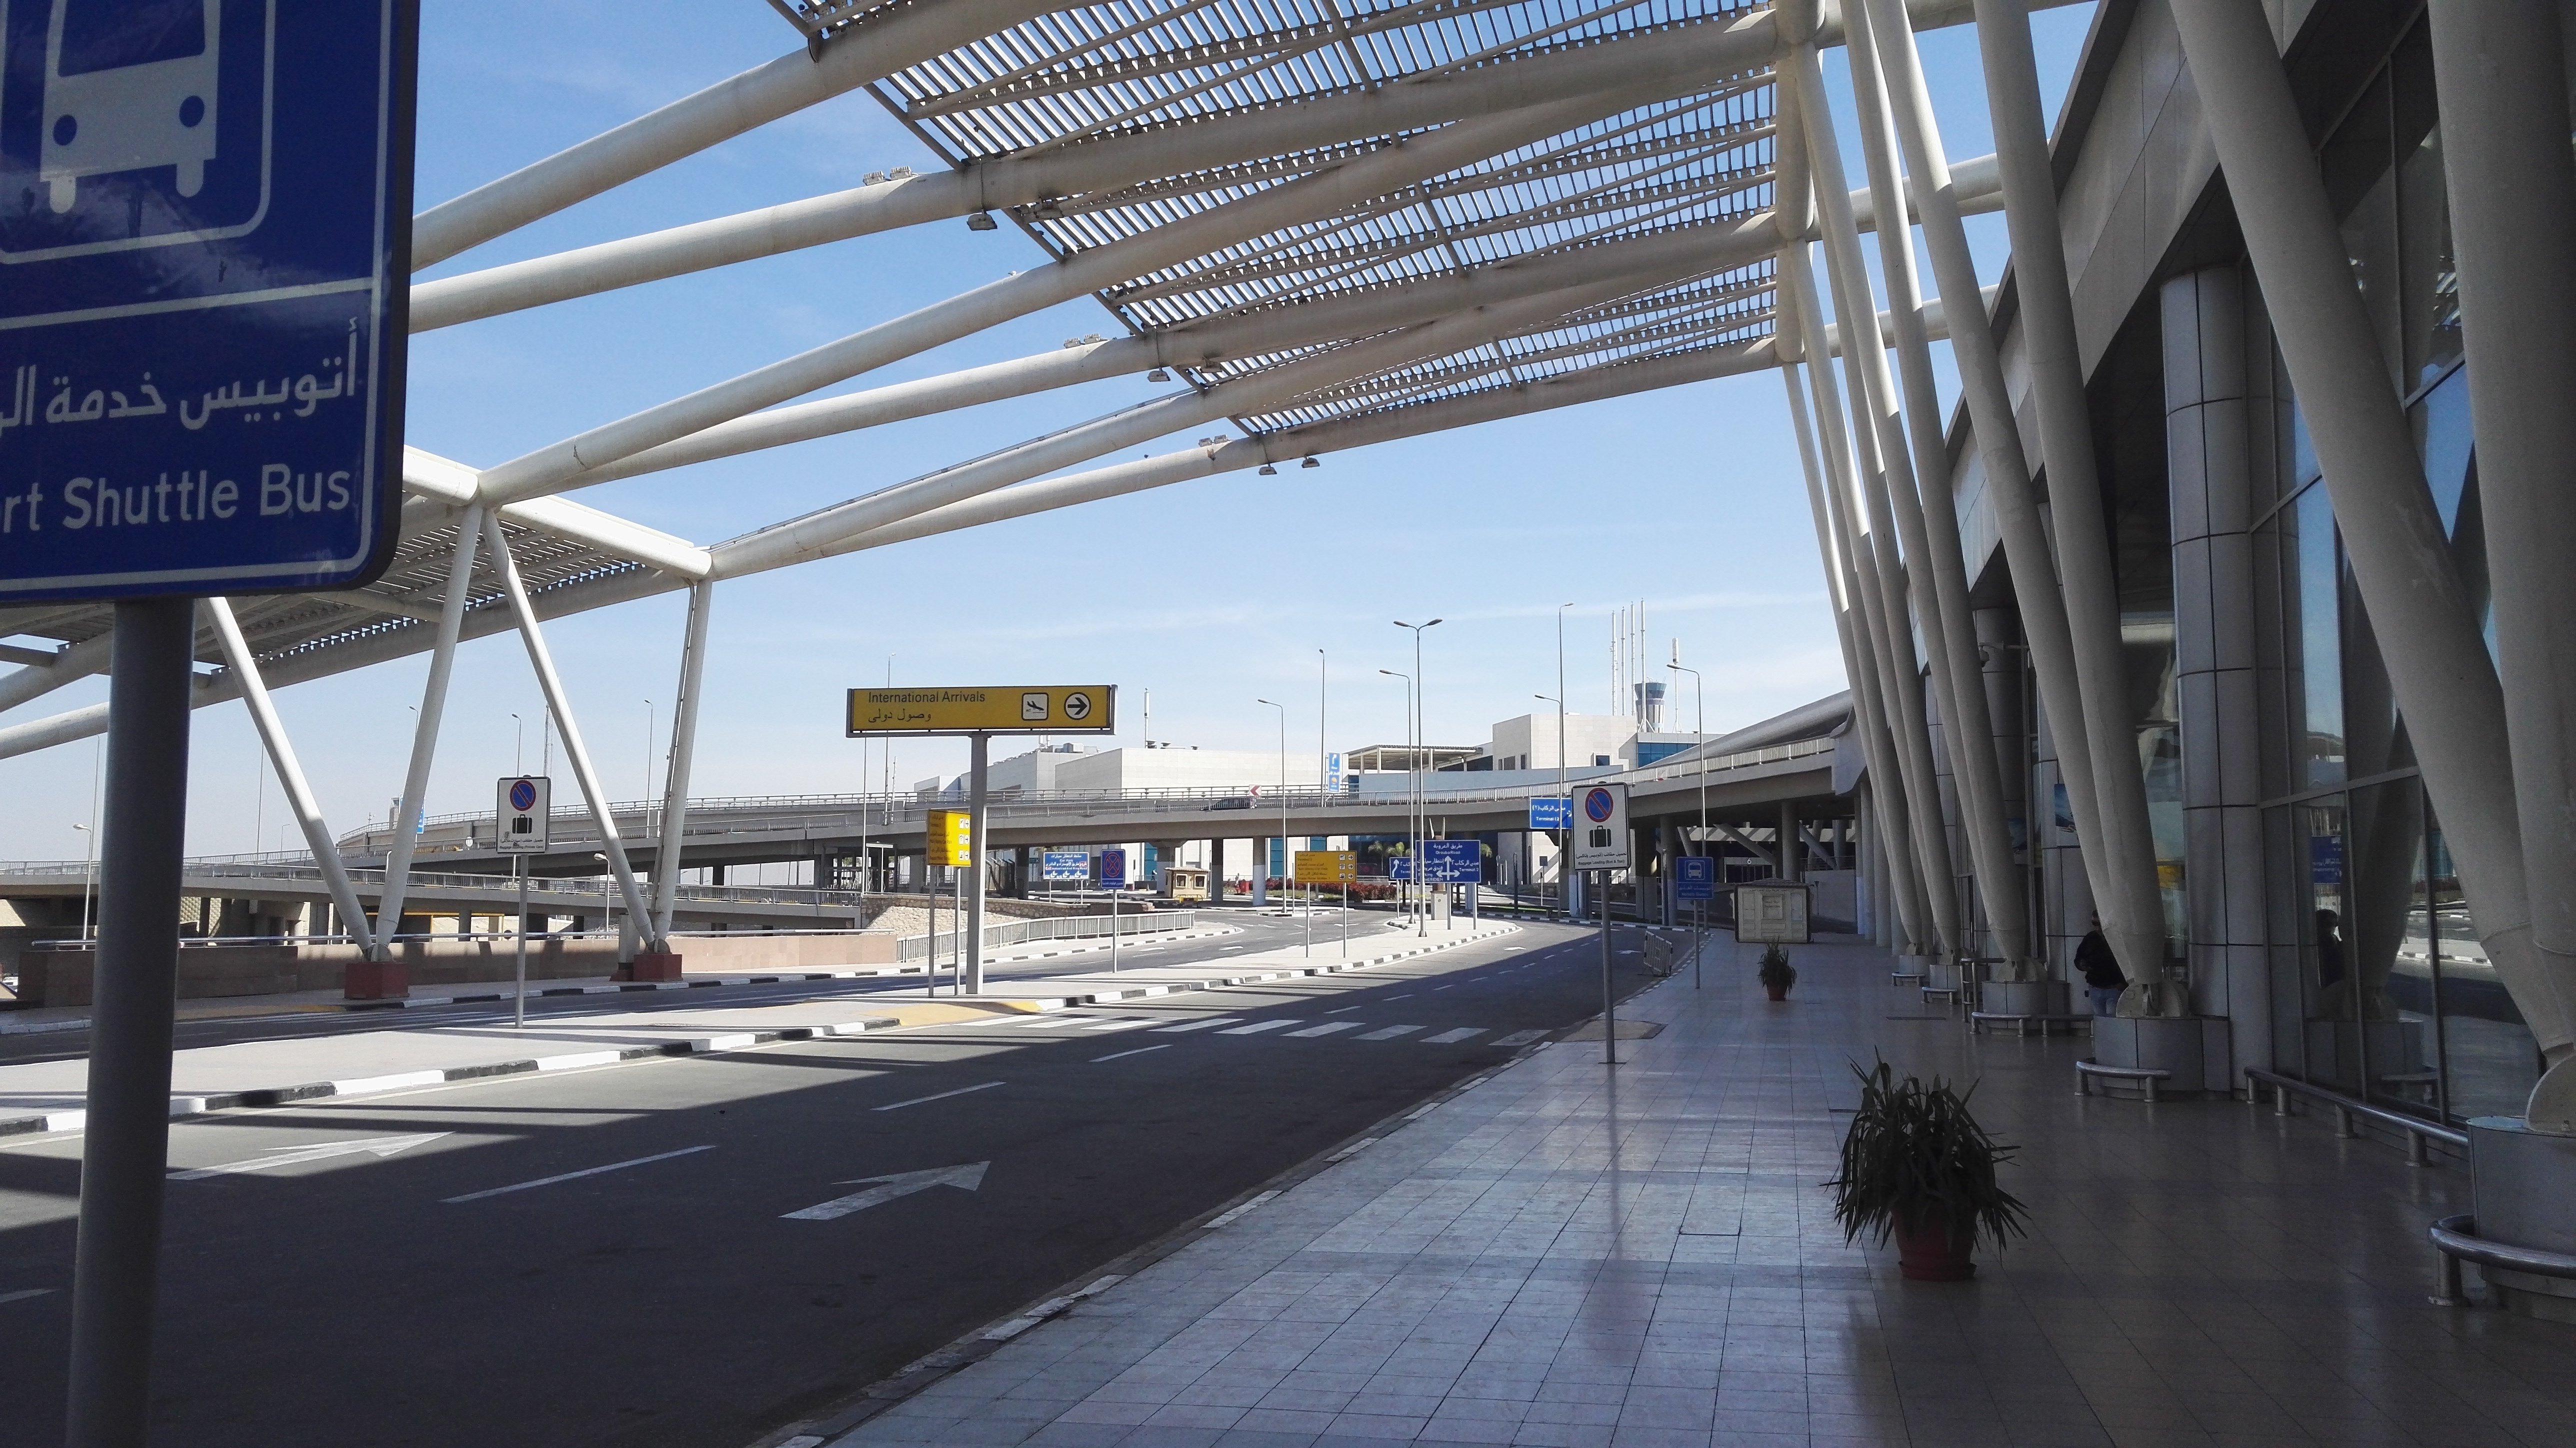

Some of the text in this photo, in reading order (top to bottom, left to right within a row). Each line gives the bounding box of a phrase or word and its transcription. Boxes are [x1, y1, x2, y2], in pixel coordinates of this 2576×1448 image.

[46, 372, 166, 424] خدمة
[180, 316, 358, 430] أتوبيس
[62, 470, 238, 529] Shuttle
[260, 463, 350, 516] Bus
[868, 690, 986, 703] International Arrivals
[898, 708, 931, 722] وصول
